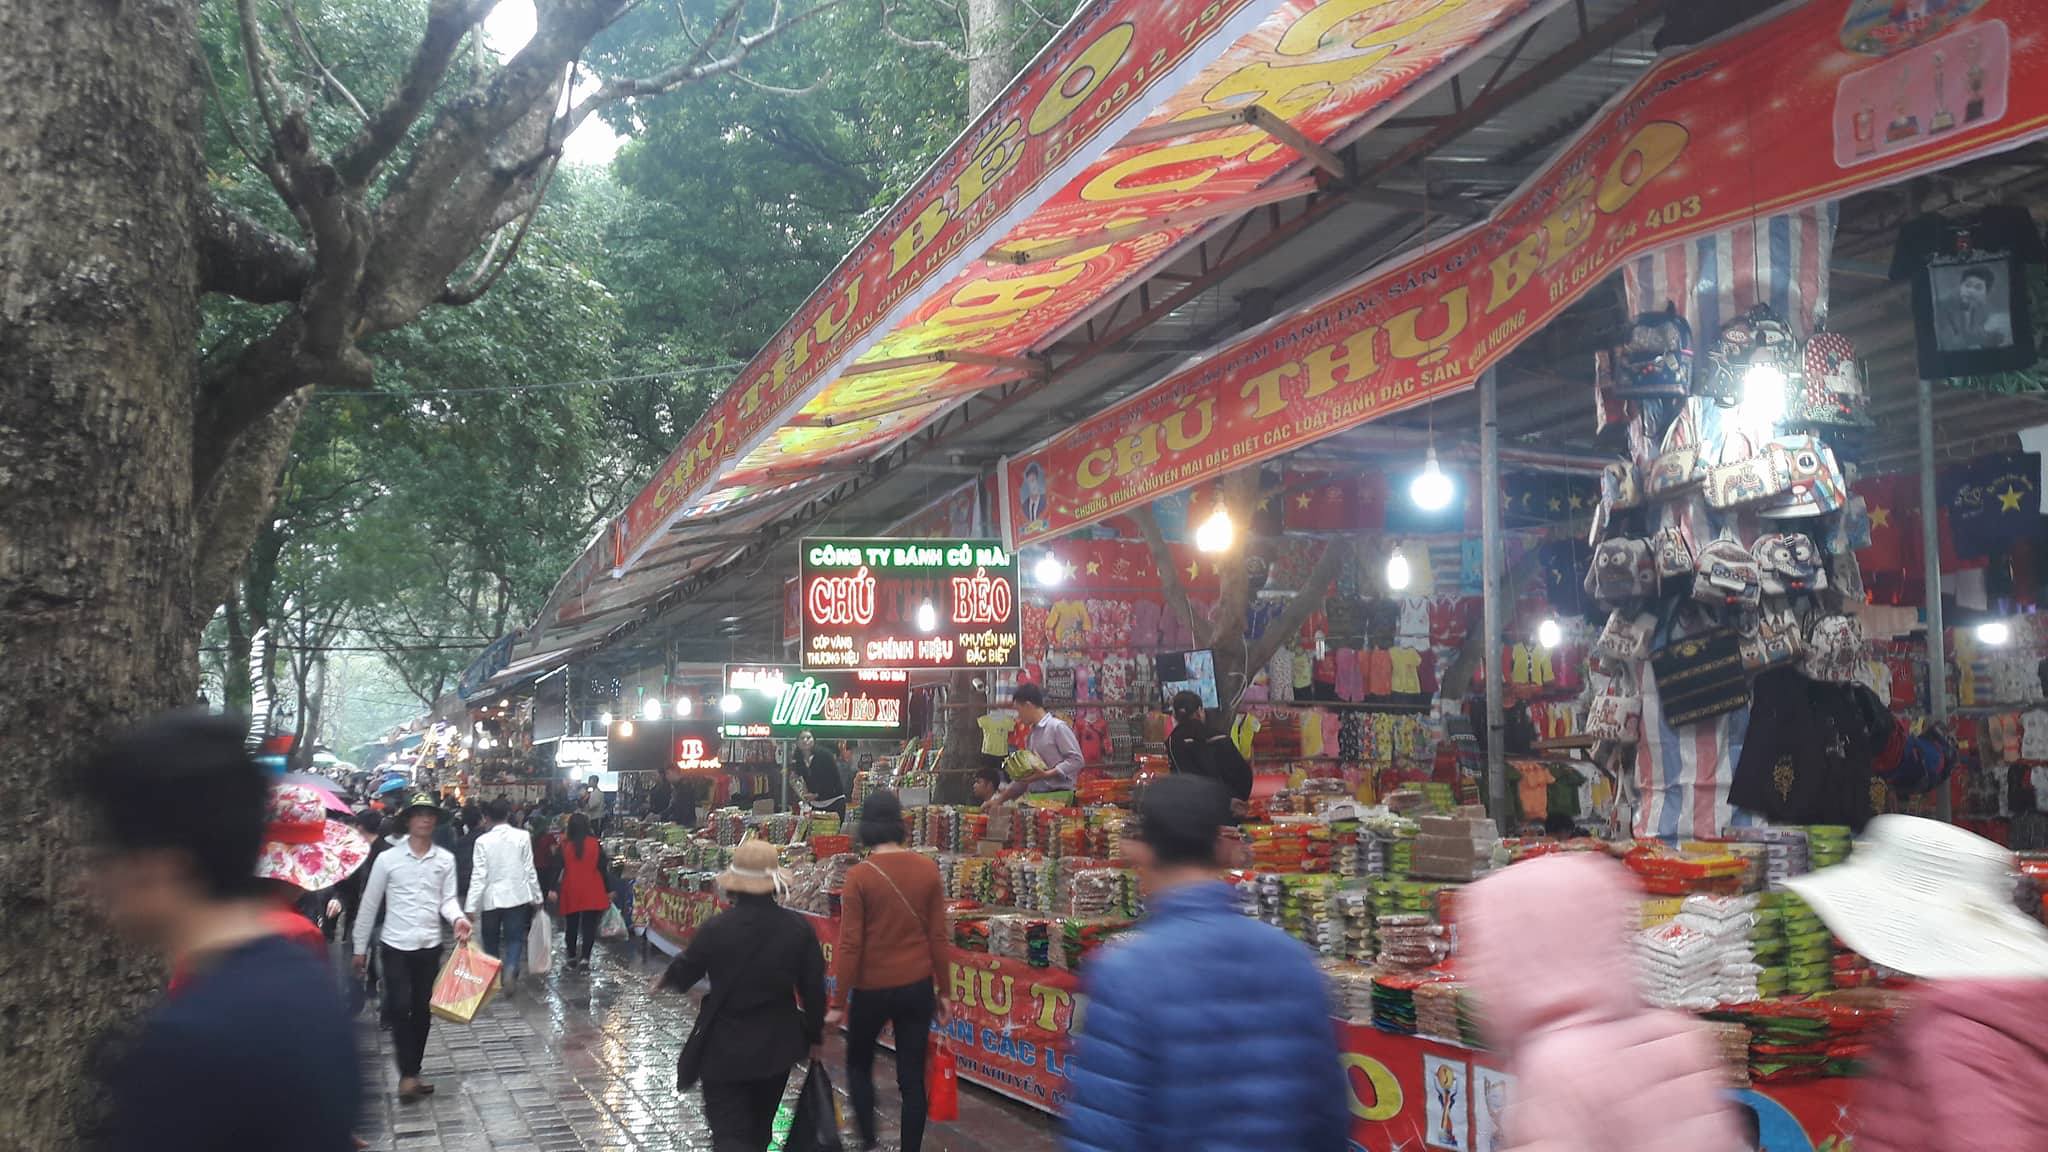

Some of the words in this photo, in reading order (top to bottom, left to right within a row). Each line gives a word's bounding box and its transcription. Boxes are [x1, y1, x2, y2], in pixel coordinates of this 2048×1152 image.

[1095, 48, 1168, 118] 0912
[1645, 195, 1701, 229] 403
[653, 414, 726, 509] CHÚ
[737, 273, 863, 421] THỤ
[887, 21, 1135, 281] BÉO
[1076, 394, 1217, 489] CHÚ
[1240, 286, 1470, 419] THỤ
[1486, 119, 1690, 315] BÉO
[810, 545, 862, 567] CÔNG
[866, 548, 891, 566] TY
[894, 545, 944, 567] BÁNH
[947, 543, 973, 567] CỦ
[808, 566, 875, 625] CHÚ
[952, 567, 1012, 624] BÉO
[866, 637, 914, 660] CHÍNH
[918, 637, 954, 664] HIỆU
[959, 629, 998, 647] KHUYẾN
[1000, 633, 1016, 649] MẠI
[965, 648, 987, 666] ĐẶC
[989, 648, 1011, 665] BIỆT
[950, 960, 1015, 1016] HÚ
[982, 1028, 1036, 1066] CÁC
